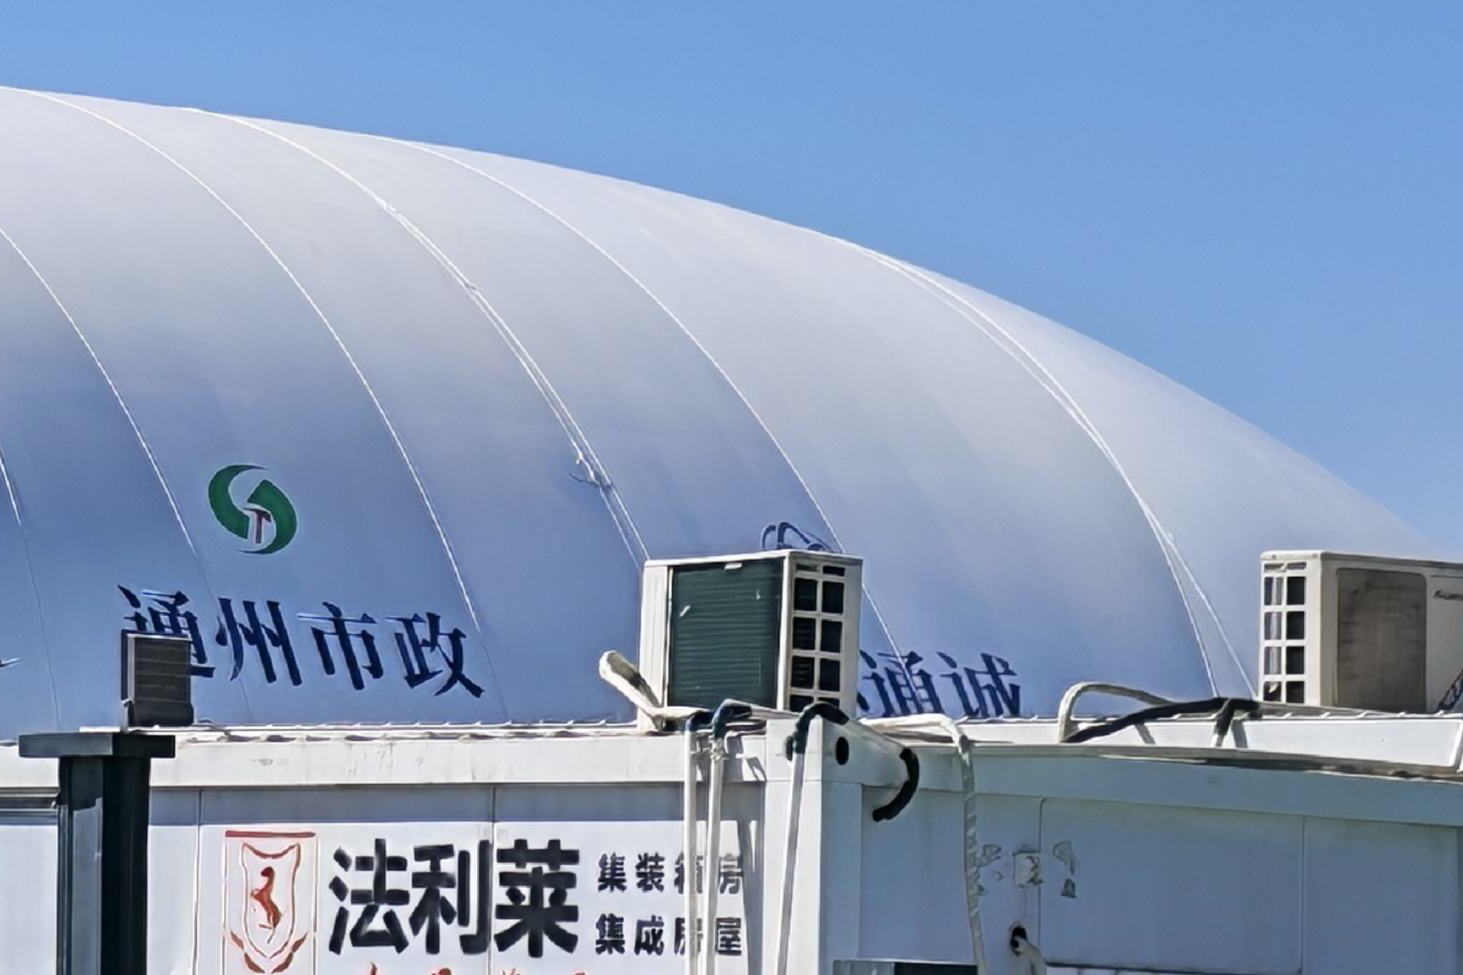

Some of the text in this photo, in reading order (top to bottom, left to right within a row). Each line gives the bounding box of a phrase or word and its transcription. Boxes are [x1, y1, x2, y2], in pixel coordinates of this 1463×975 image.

[117, 584, 485, 698] 通州市政
[856, 649, 1022, 718] 通诚
[328, 837, 580, 958] 法利莱
